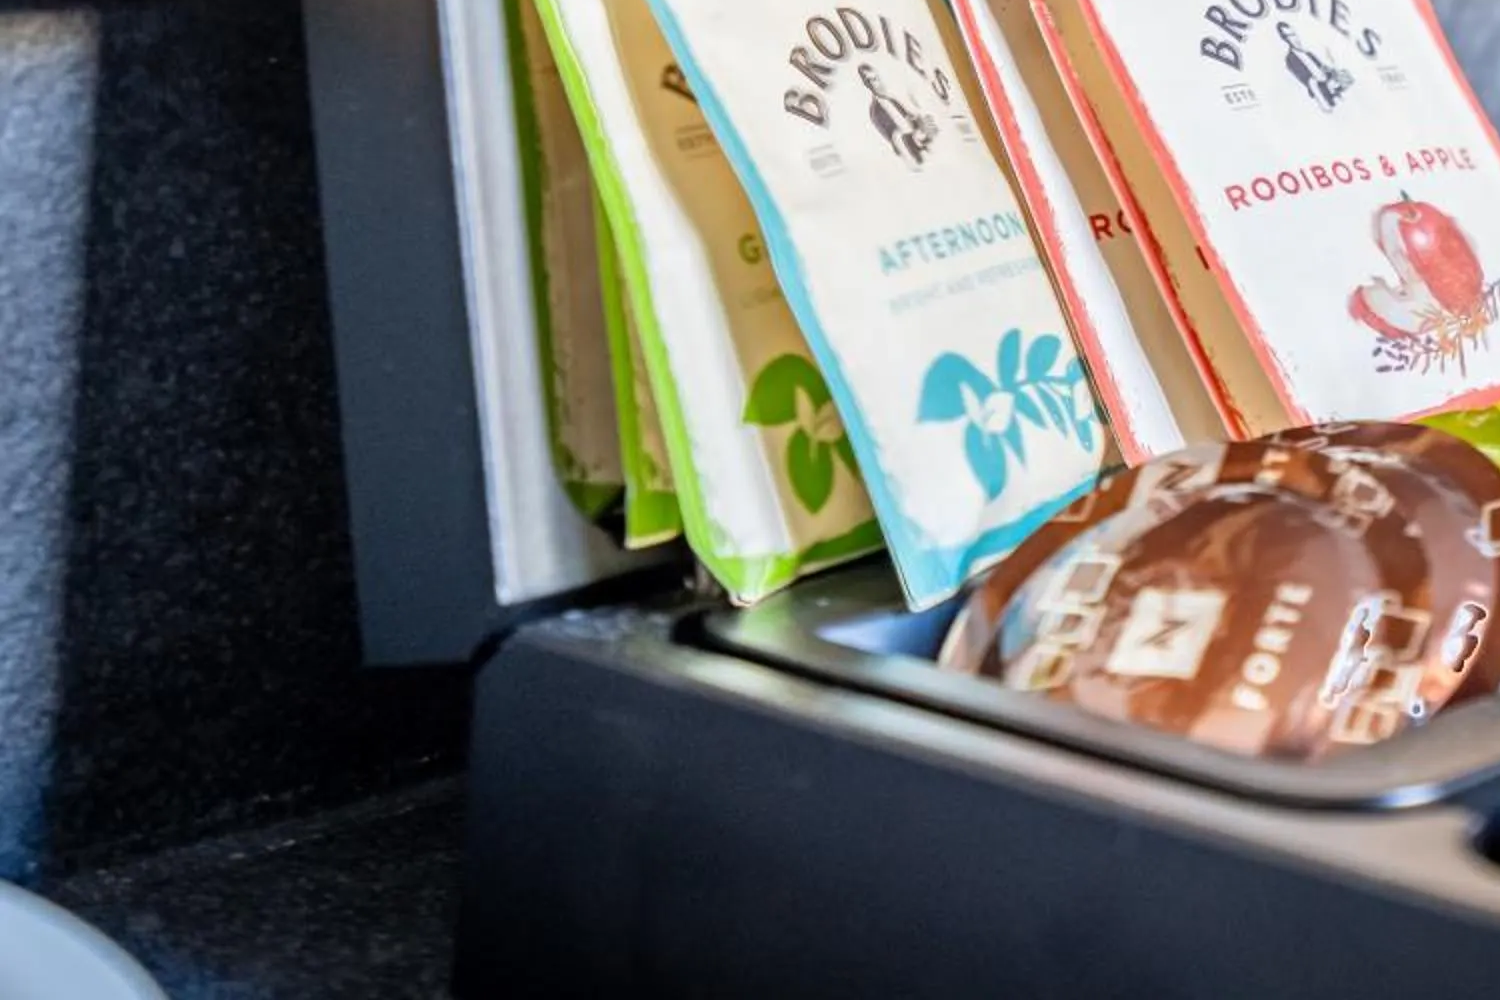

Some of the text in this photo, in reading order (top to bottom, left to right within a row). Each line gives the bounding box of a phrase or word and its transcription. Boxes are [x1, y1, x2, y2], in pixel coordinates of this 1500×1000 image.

[783, 6, 951, 127] BRODIES
[1224, 147, 1477, 211] ROOIBOS & APPLE
[877, 211, 1027, 277] AFTERNOON
